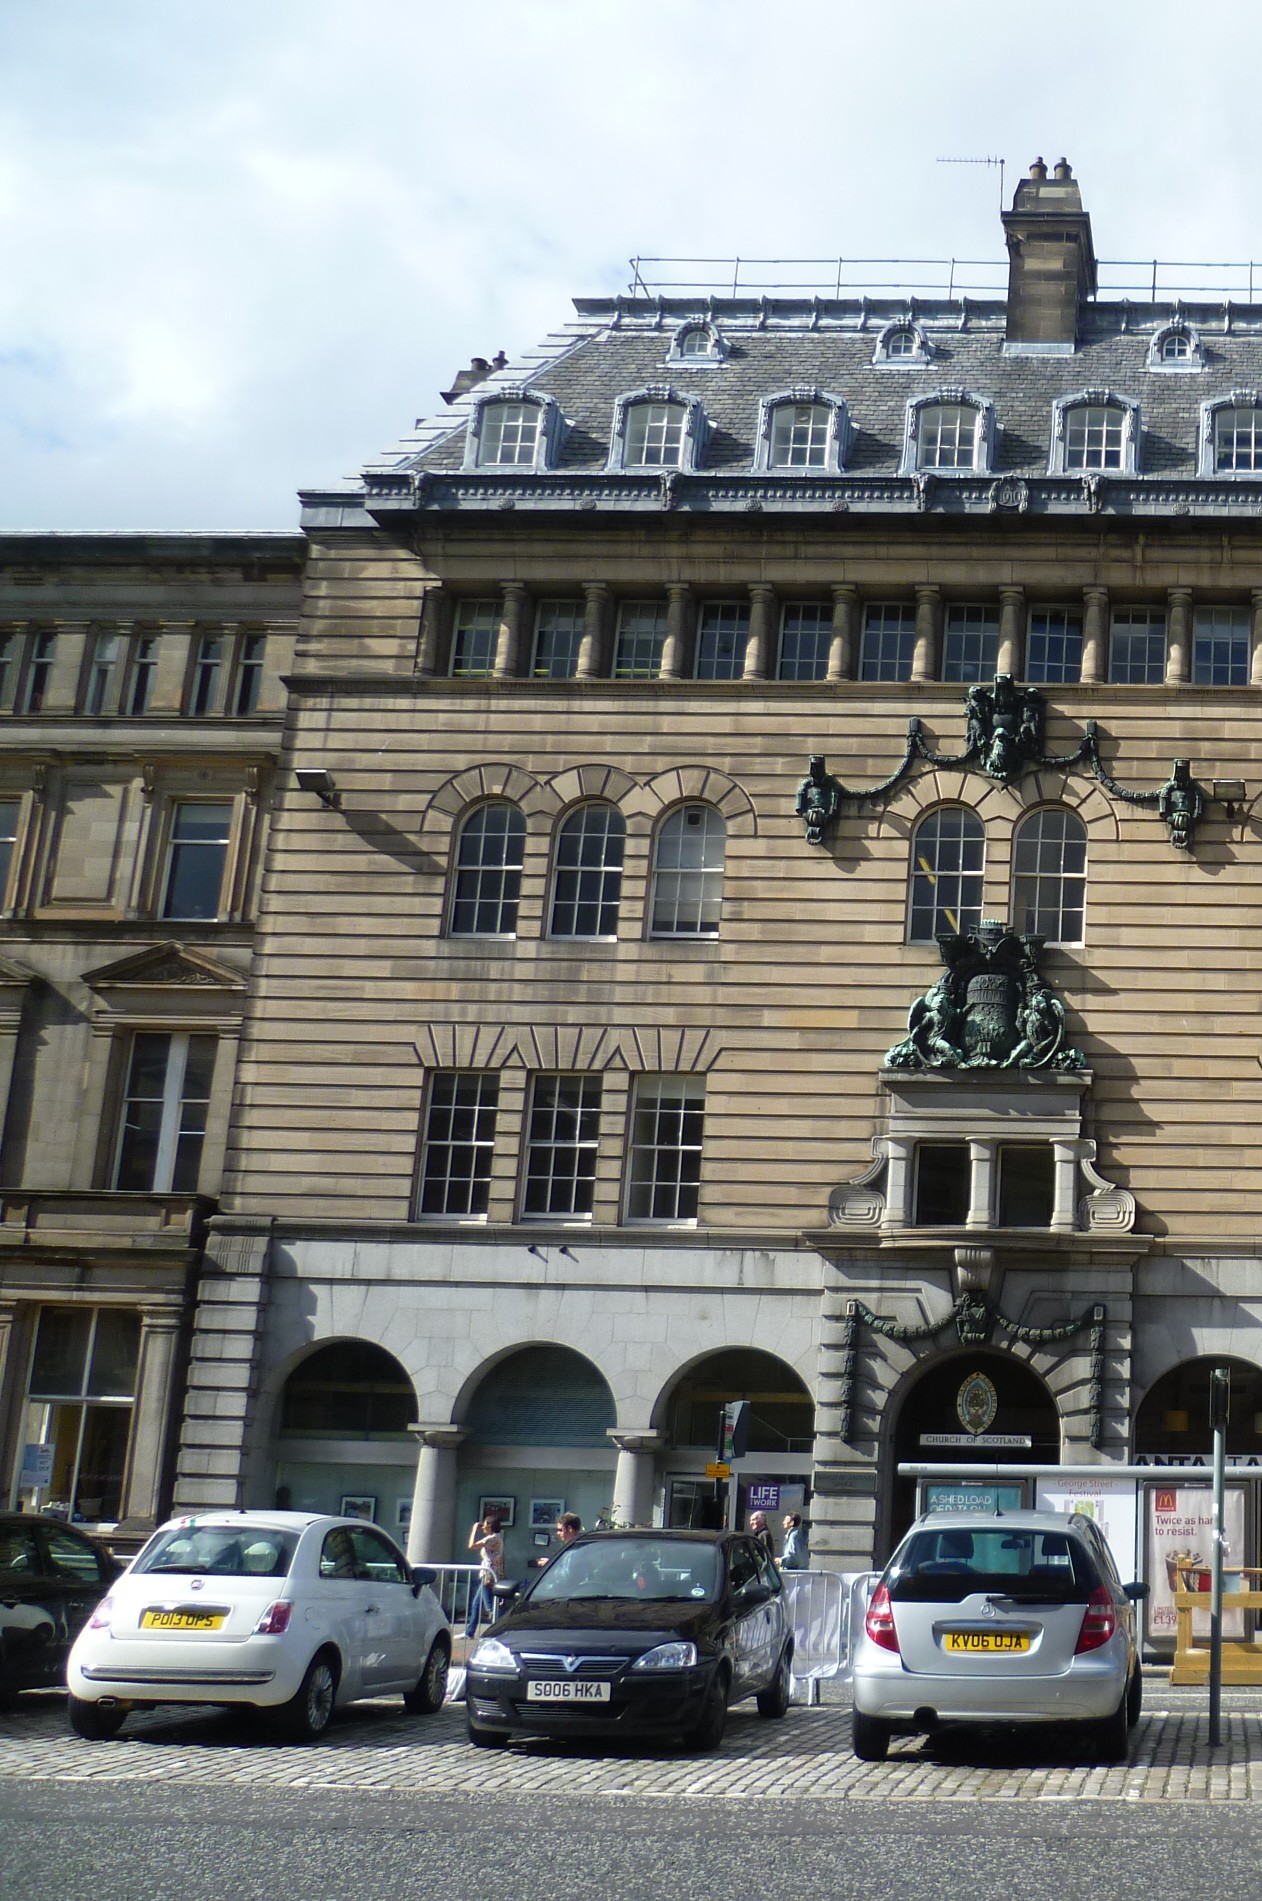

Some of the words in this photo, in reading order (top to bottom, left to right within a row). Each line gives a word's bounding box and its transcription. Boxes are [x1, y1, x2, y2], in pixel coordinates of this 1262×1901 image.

[925, 1435, 962, 1444] CHURCH
[966, 1436, 978, 1444] OF
[982, 1436, 1026, 1445] SCOTLAND
[1057, 1479, 1088, 1490] George
[1090, 1479, 1113, 1489] Street
[750, 1486, 778, 1499] LIFE
[1069, 1488, 1102, 1497] Festival
[930, 1495, 938, 1504] A
[938, 1495, 964, 1504] SHED
[965, 1495, 992, 1505] LOAD
[1155, 1515, 1182, 1525] Twice
[1184, 1517, 1196, 1525] as
[1198, 1515, 1214, 1525] har
[1155, 1527, 1164, 1536] to
[1166, 1526, 1197, 1536] resist.
[151, 1613, 183, 1627] PO13
[186, 1614, 214, 1628] OPS
[951, 1633, 990, 1649] KV06
[994, 1634, 1022, 1649] OJA
[534, 1682, 571, 1697] SO06
[574, 1683, 603, 1698] HKA
